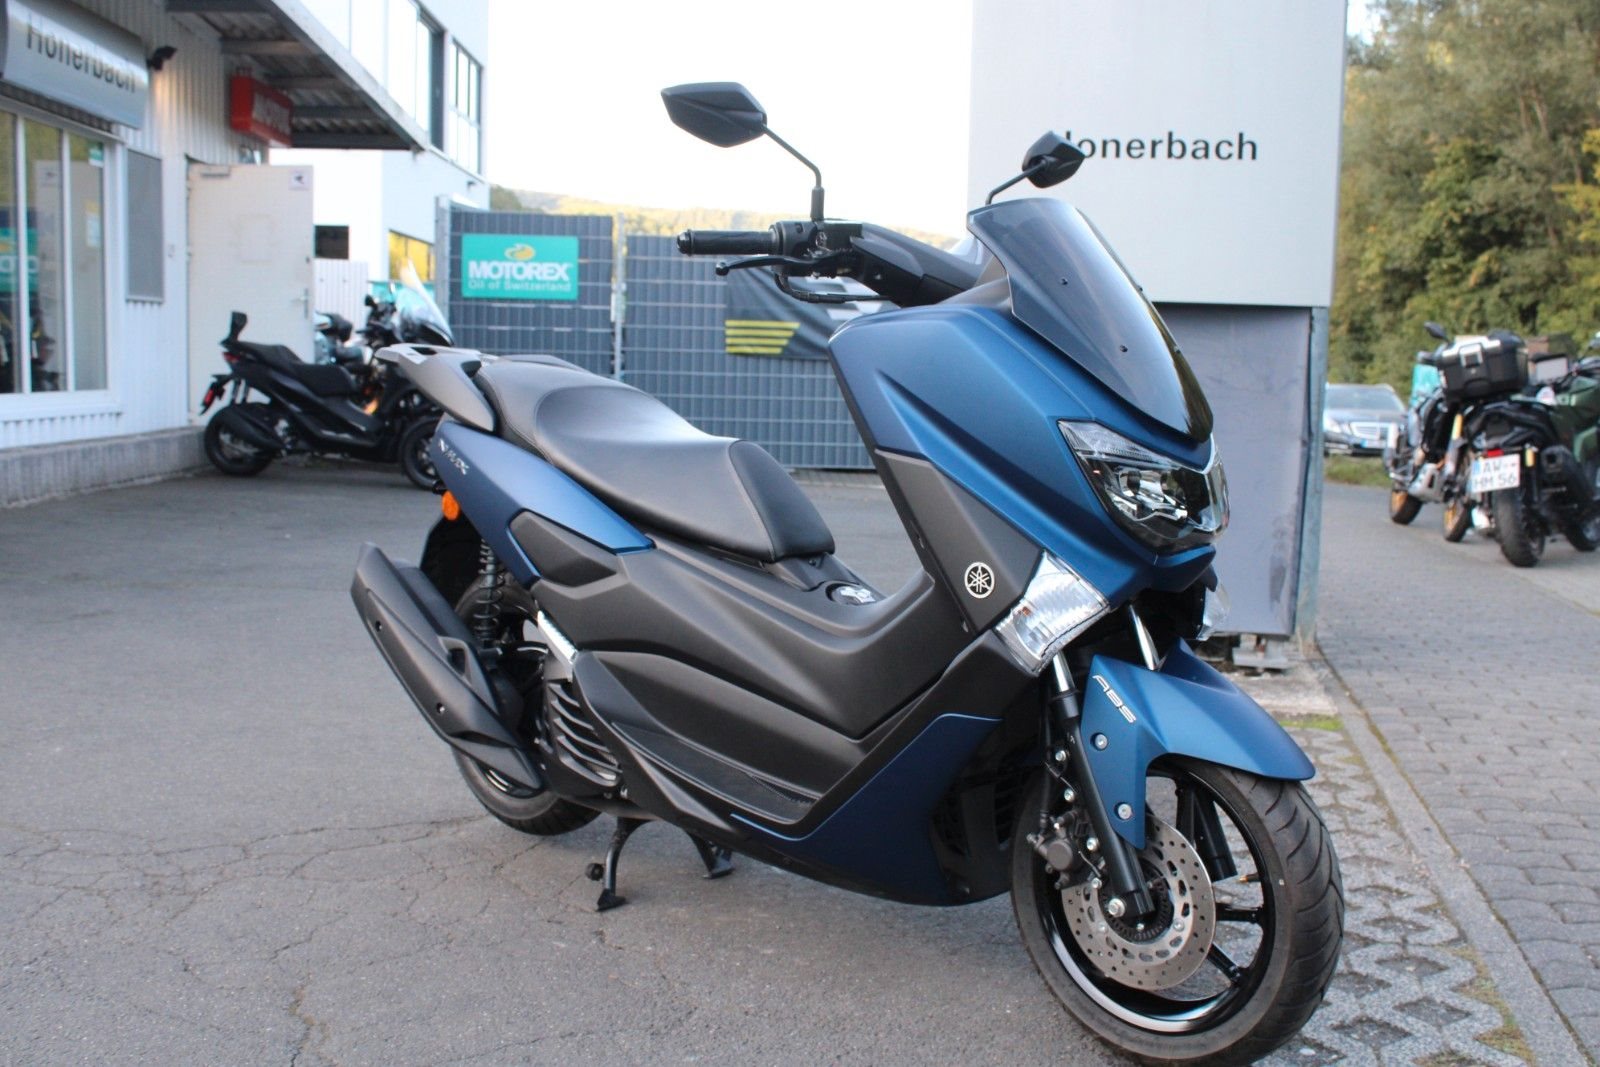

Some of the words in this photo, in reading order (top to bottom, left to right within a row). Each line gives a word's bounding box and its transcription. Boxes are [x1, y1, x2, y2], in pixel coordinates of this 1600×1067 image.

[1065, 130, 1258, 161] onerbach
[467, 260, 575, 281] MOTOREX
[468, 280, 485, 290] Oil
[488, 281, 500, 290] of
[504, 280, 572, 292] Switzerland
[1092, 674, 1137, 724] ABS
